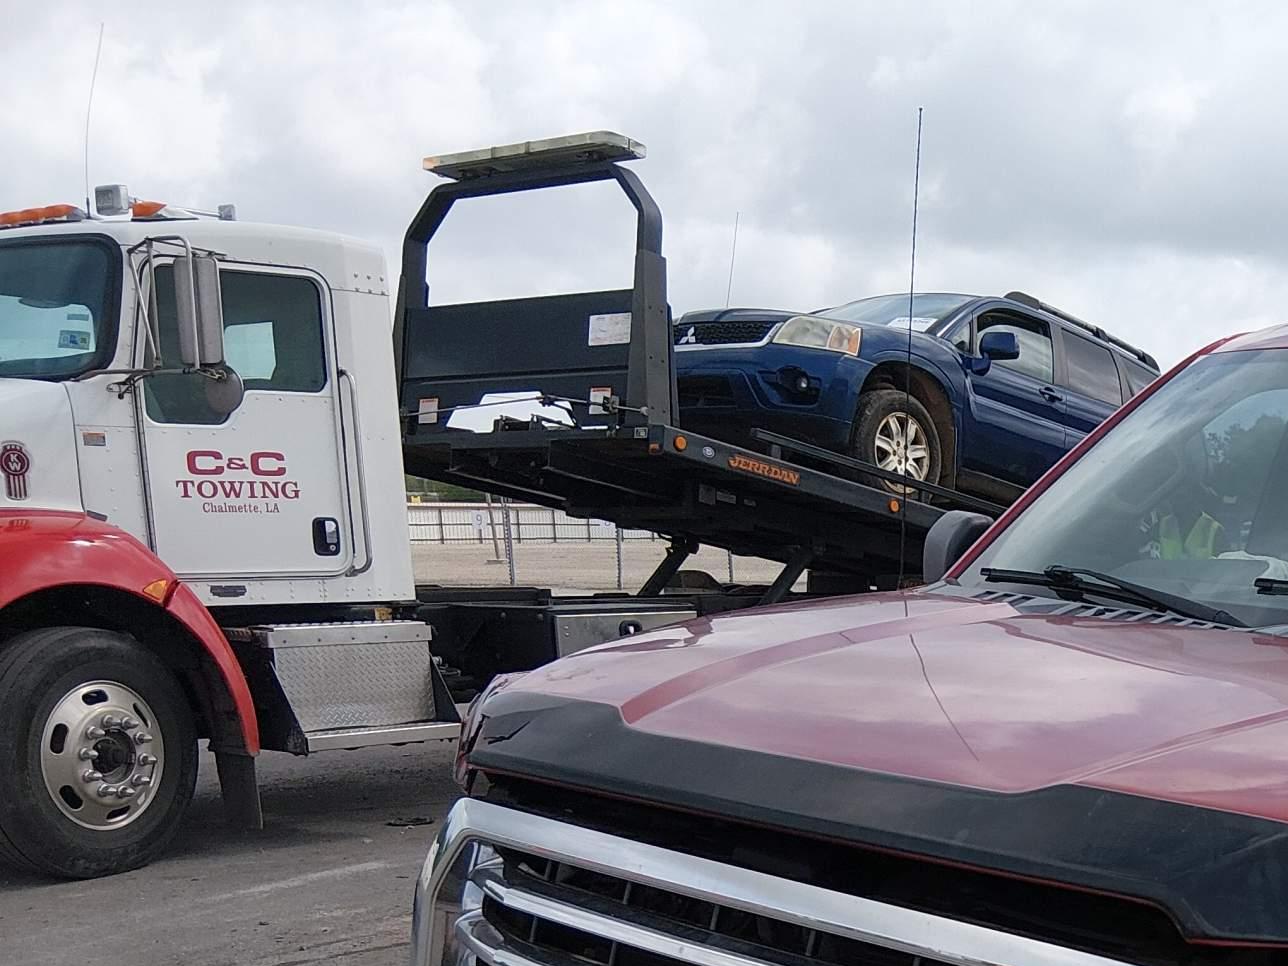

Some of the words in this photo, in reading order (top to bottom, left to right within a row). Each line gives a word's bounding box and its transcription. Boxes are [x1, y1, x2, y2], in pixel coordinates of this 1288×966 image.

[186, 450, 287, 477] C&C
[175, 480, 301, 499] TOWING
[202, 502, 263, 514] Chalmette,
[265, 502, 280, 513] LA
